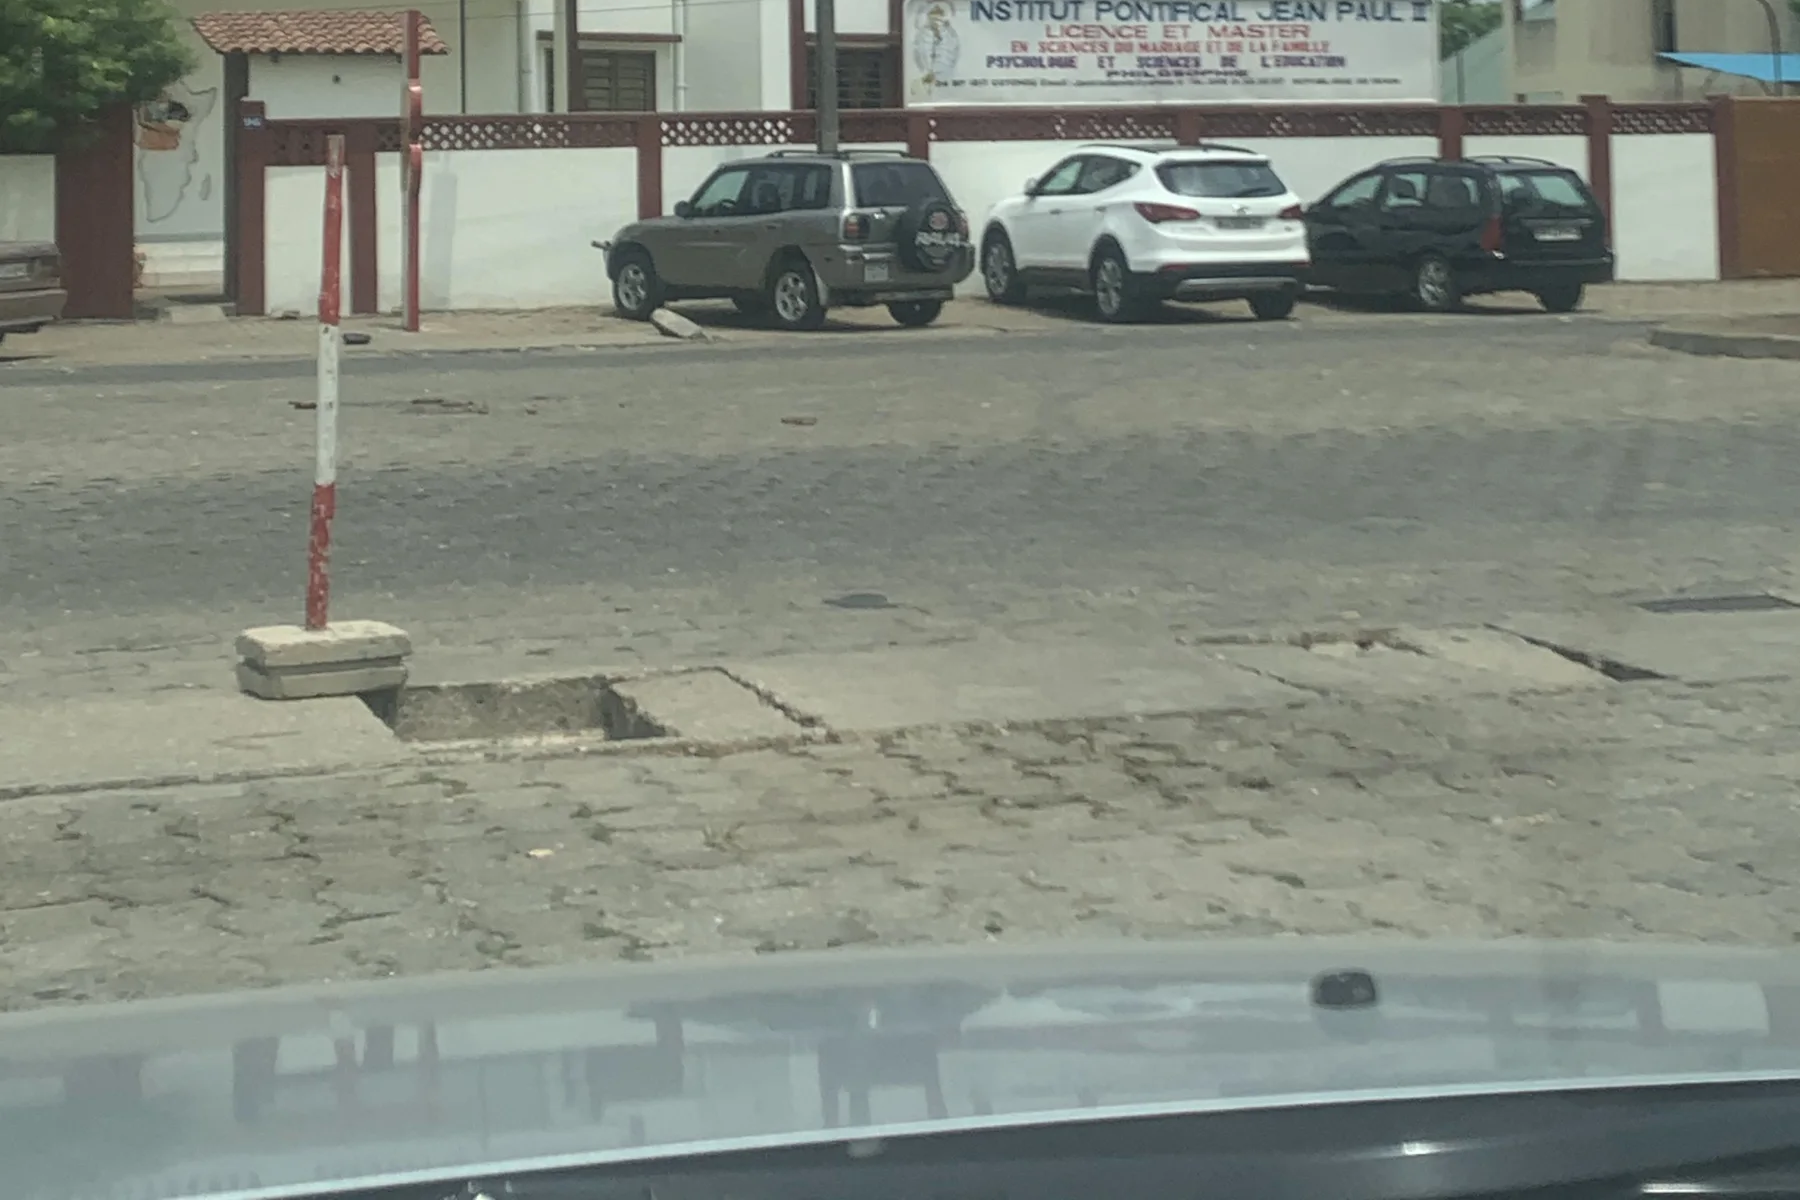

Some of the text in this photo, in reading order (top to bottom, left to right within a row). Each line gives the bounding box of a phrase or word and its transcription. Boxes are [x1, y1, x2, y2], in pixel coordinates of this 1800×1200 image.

[970, 0, 1428, 22] INSTITUT PONTIFICAL JEAN PAUL II
[1045, 24, 1311, 38] LICENCE ET MASTER
[1011, 41, 1028, 53] EN
[1038, 41, 1108, 53] SCIENCES
[1139, 41, 1200, 53] MARIAGE
[1206, 41, 1221, 53] ET
[1249, 41, 1267, 53] LA
[1098, 55, 1115, 68] ET
[1137, 55, 1202, 68] SCIENCES
